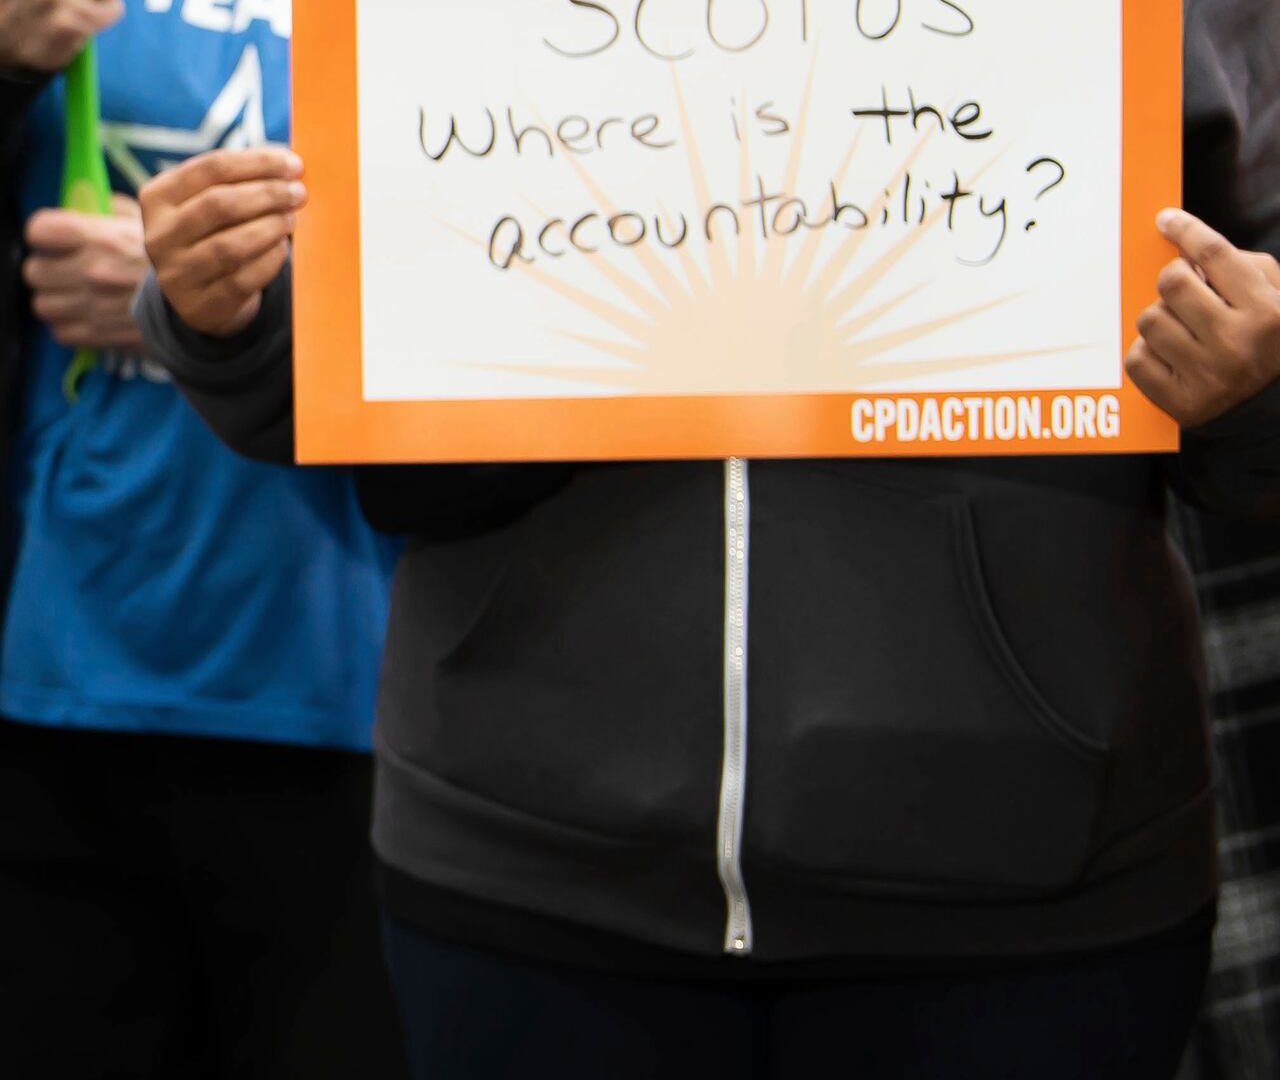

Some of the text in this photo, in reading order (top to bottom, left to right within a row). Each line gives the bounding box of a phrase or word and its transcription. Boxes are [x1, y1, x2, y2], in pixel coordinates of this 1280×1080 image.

[418, 84, 996, 163] Where is the
[488, 156, 1067, 269] accountability?
[851, 394, 1120, 443] CPDACTION.ORG
